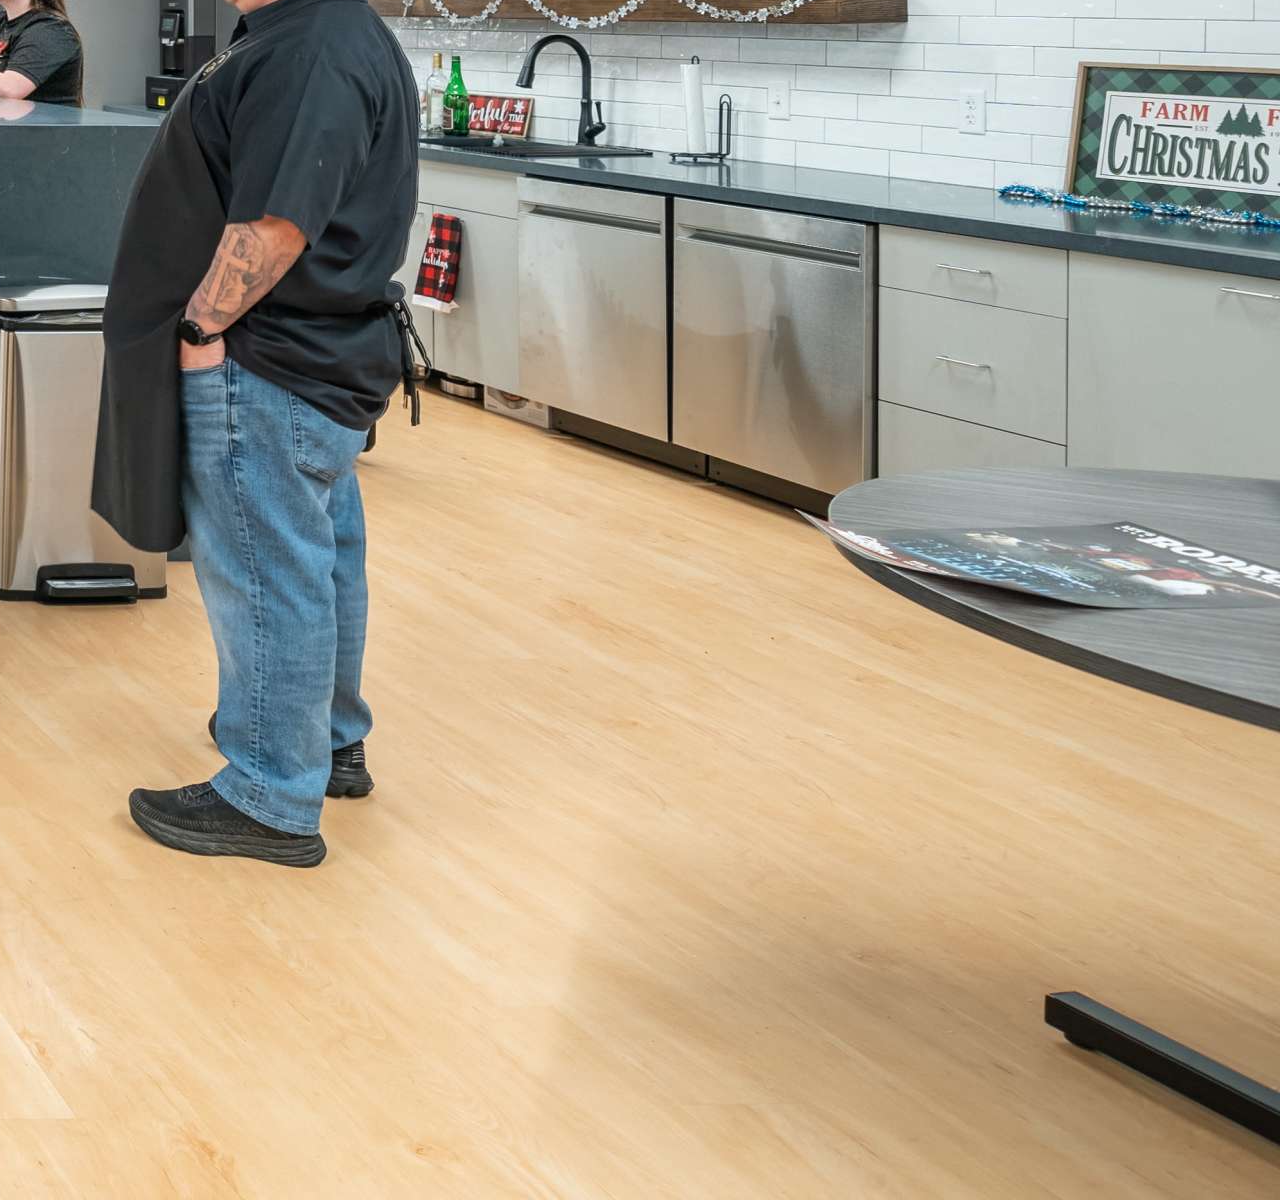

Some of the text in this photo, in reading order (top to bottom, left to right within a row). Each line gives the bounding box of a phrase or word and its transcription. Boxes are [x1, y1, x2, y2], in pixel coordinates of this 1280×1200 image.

[508, 113, 525, 123] TIME
[1140, 100, 1210, 122] FARM
[1107, 113, 1270, 185] CHRISTMAS
